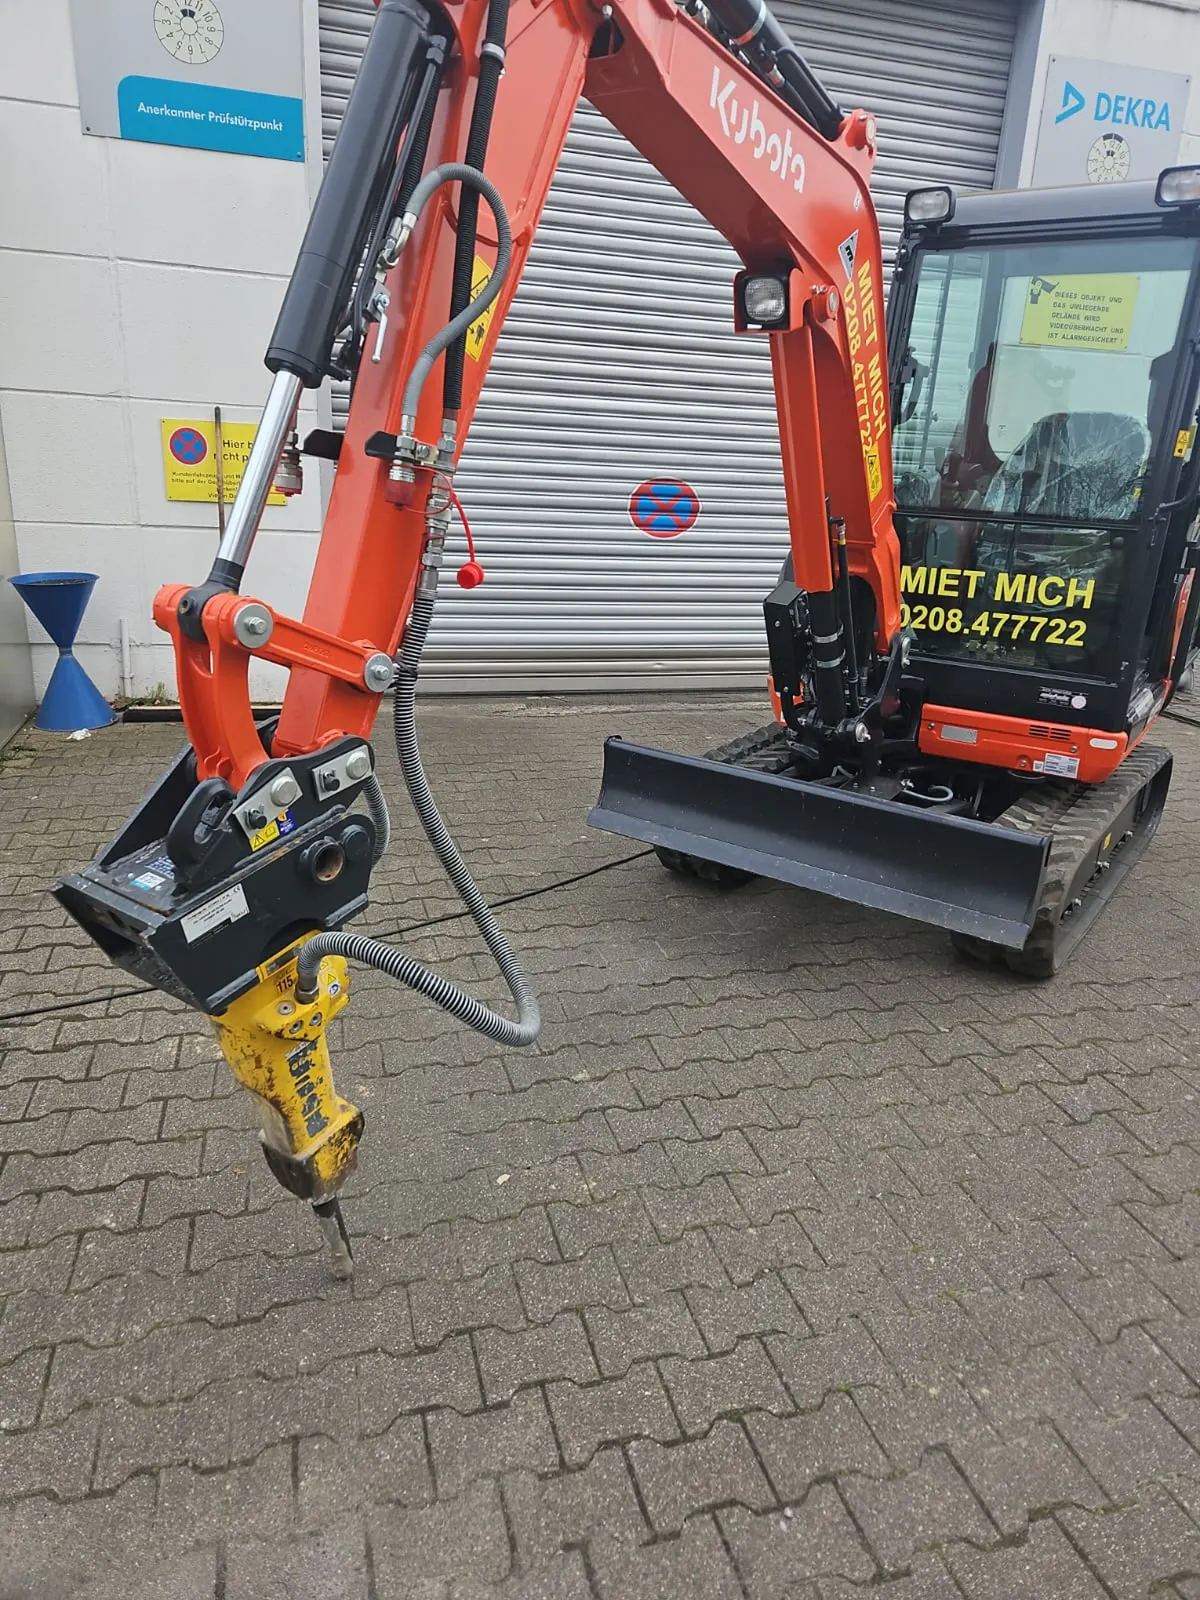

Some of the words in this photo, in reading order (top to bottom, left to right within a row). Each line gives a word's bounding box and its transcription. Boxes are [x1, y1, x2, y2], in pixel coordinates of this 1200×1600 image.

[195, 1, 204, 11] 11
[202, 11, 214, 22] 10
[176, 40, 183, 50] 5
[204, 36, 213, 46] 8
[198, 43, 207, 54] 7
[137, 101, 205, 121] Anerkannter
[208, 111, 283, 132] Prüfstützpunkt
[1094, 92, 1170, 131] DEKRA
[709, 65, 805, 194] Kubota
[1054, 291, 1077, 299] DIESES
[1081, 294, 1106, 302] OBJEKT
[1109, 296, 1123, 304] UND
[1051, 311, 1080, 320] GELÄNDE
[1061, 333, 1118, 344] ALARMGESICHERT
[857, 259, 878, 347] MIET
[868, 352, 887, 440] MICH
[844, 281, 873, 458] 0208.477722
[222, 439, 245, 449] Hier
[900, 565, 986, 599] MIET
[994, 572, 1096, 609] MICH
[900, 603, 1087, 647] 0208.477722
[276, 974, 294, 994] 115
